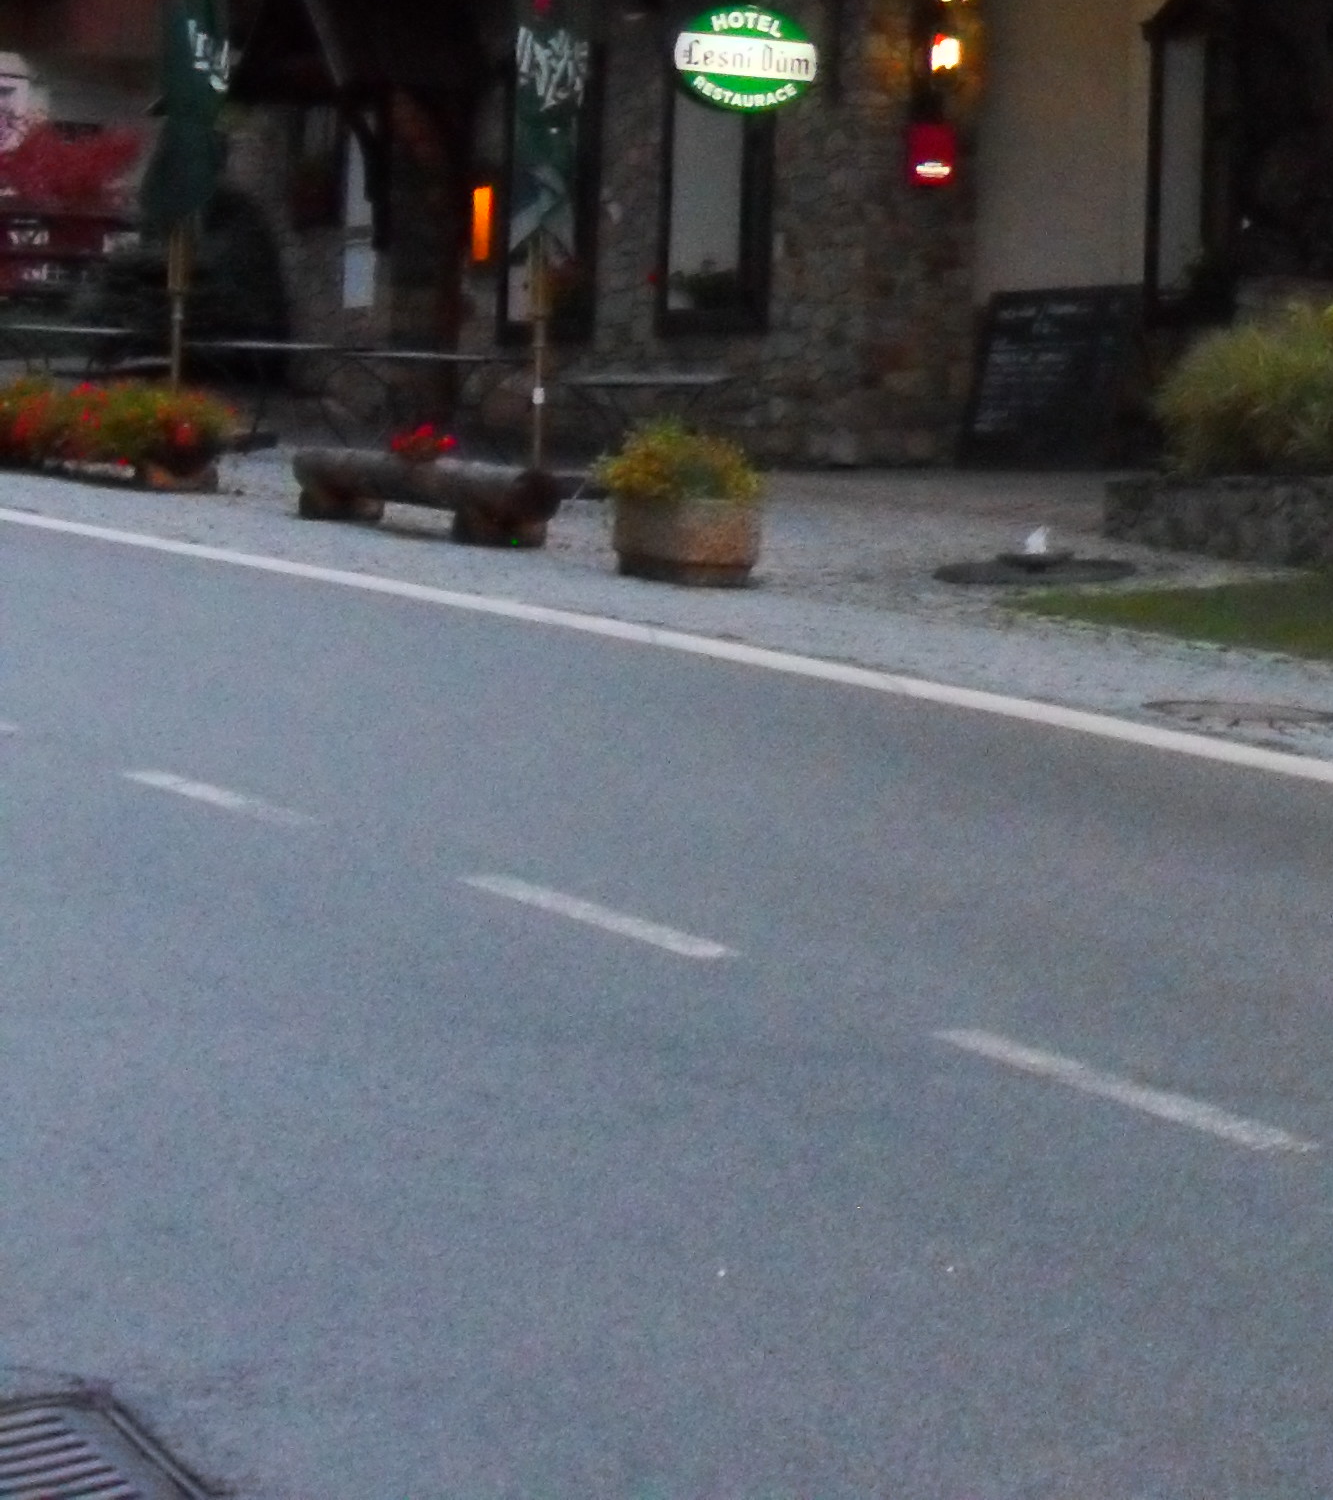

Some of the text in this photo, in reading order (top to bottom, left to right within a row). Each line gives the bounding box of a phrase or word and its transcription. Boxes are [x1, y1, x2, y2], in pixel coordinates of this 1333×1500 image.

[710, 11, 782, 38] HOTEL
[683, 39, 753, 69] Lesní
[693, 75, 798, 108] RESTAURACE
